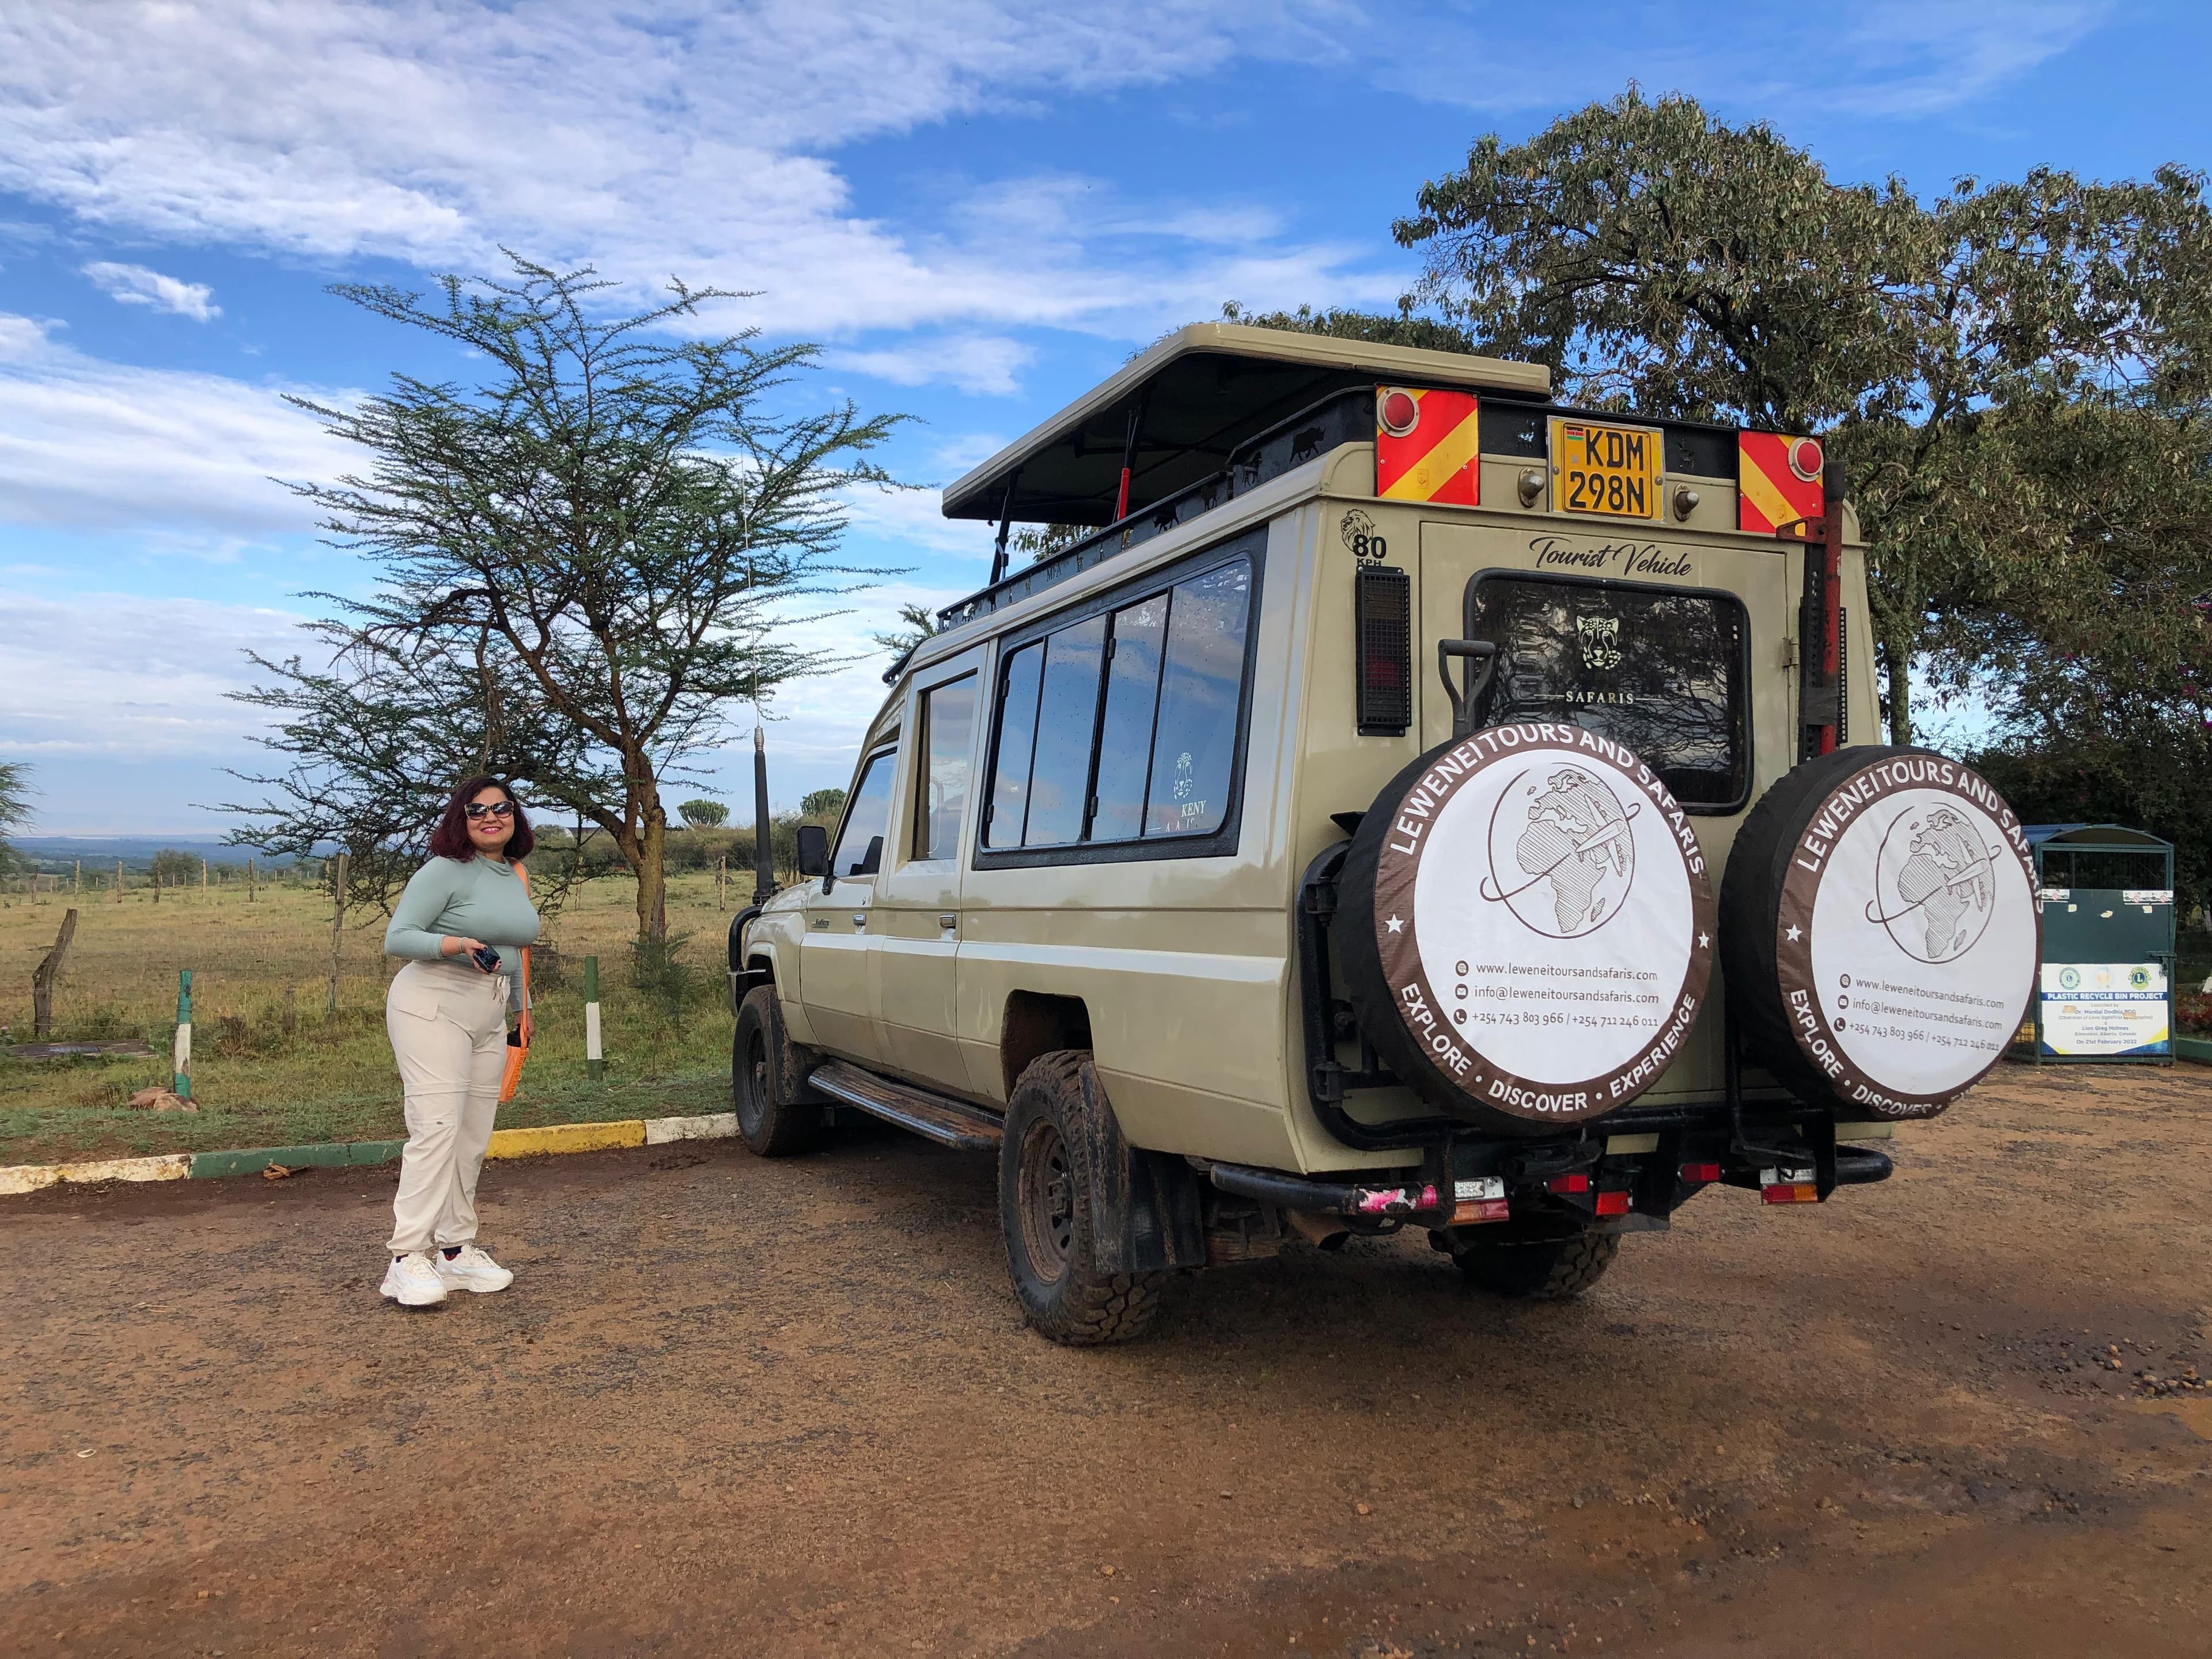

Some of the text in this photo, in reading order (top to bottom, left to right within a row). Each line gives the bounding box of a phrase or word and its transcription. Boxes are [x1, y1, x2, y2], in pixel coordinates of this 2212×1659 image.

[1586, 429, 1643, 471] KDM
[1570, 471, 1645, 513] 298N
[1353, 534, 1387, 559] 80
[1357, 558, 1382, 566] KPH
[1529, 537, 1692, 576] Tourist Vehicle
[1566, 691, 1634, 704] SAFARIS
[1391, 724, 1704, 874] LEWENEI TOURS AND SAFARIS
[1797, 772, 1880, 872] LEWENEI
[1876, 760, 1954, 787] TOURS
[1957, 772, 1998, 812] AND
[1476, 963, 1658, 981] www.leweneitoursandsafaris.com
[1475, 986, 1659, 1003] info@leweneitoursandsafaris.com
[1856, 978, 2004, 1009] www.leweneitoursandsafaris.com
[1472, 1013, 1497, 1025] +254
[1499, 1014, 1520, 1024] 743
[1522, 1013, 1540, 1025] 803
[1543, 1013, 1564, 1027] 966
[1572, 1016, 1597, 1027] +254
[1600, 1016, 1617, 1027] 712
[1620, 1015, 1639, 1028] 246
[1642, 1018, 1658, 1027] 011
[1853, 998, 2002, 1030] info@leweneitoursandsafaris.com
[1401, 983, 1696, 1112] EXPLORE DISCOVER EXPERIENCE
[1790, 989, 1844, 1078] EXPLORE
[1849, 1022, 1870, 1035] +254
[1872, 1026, 1888, 1037] 743
[1890, 1027, 1905, 1040] 803
[1907, 1030, 1924, 1041] 966
[1931, 1035, 1951, 1046] +254
[1953, 1038, 1968, 1047] 712
[1970, 1039, 1986, 1050] 246
